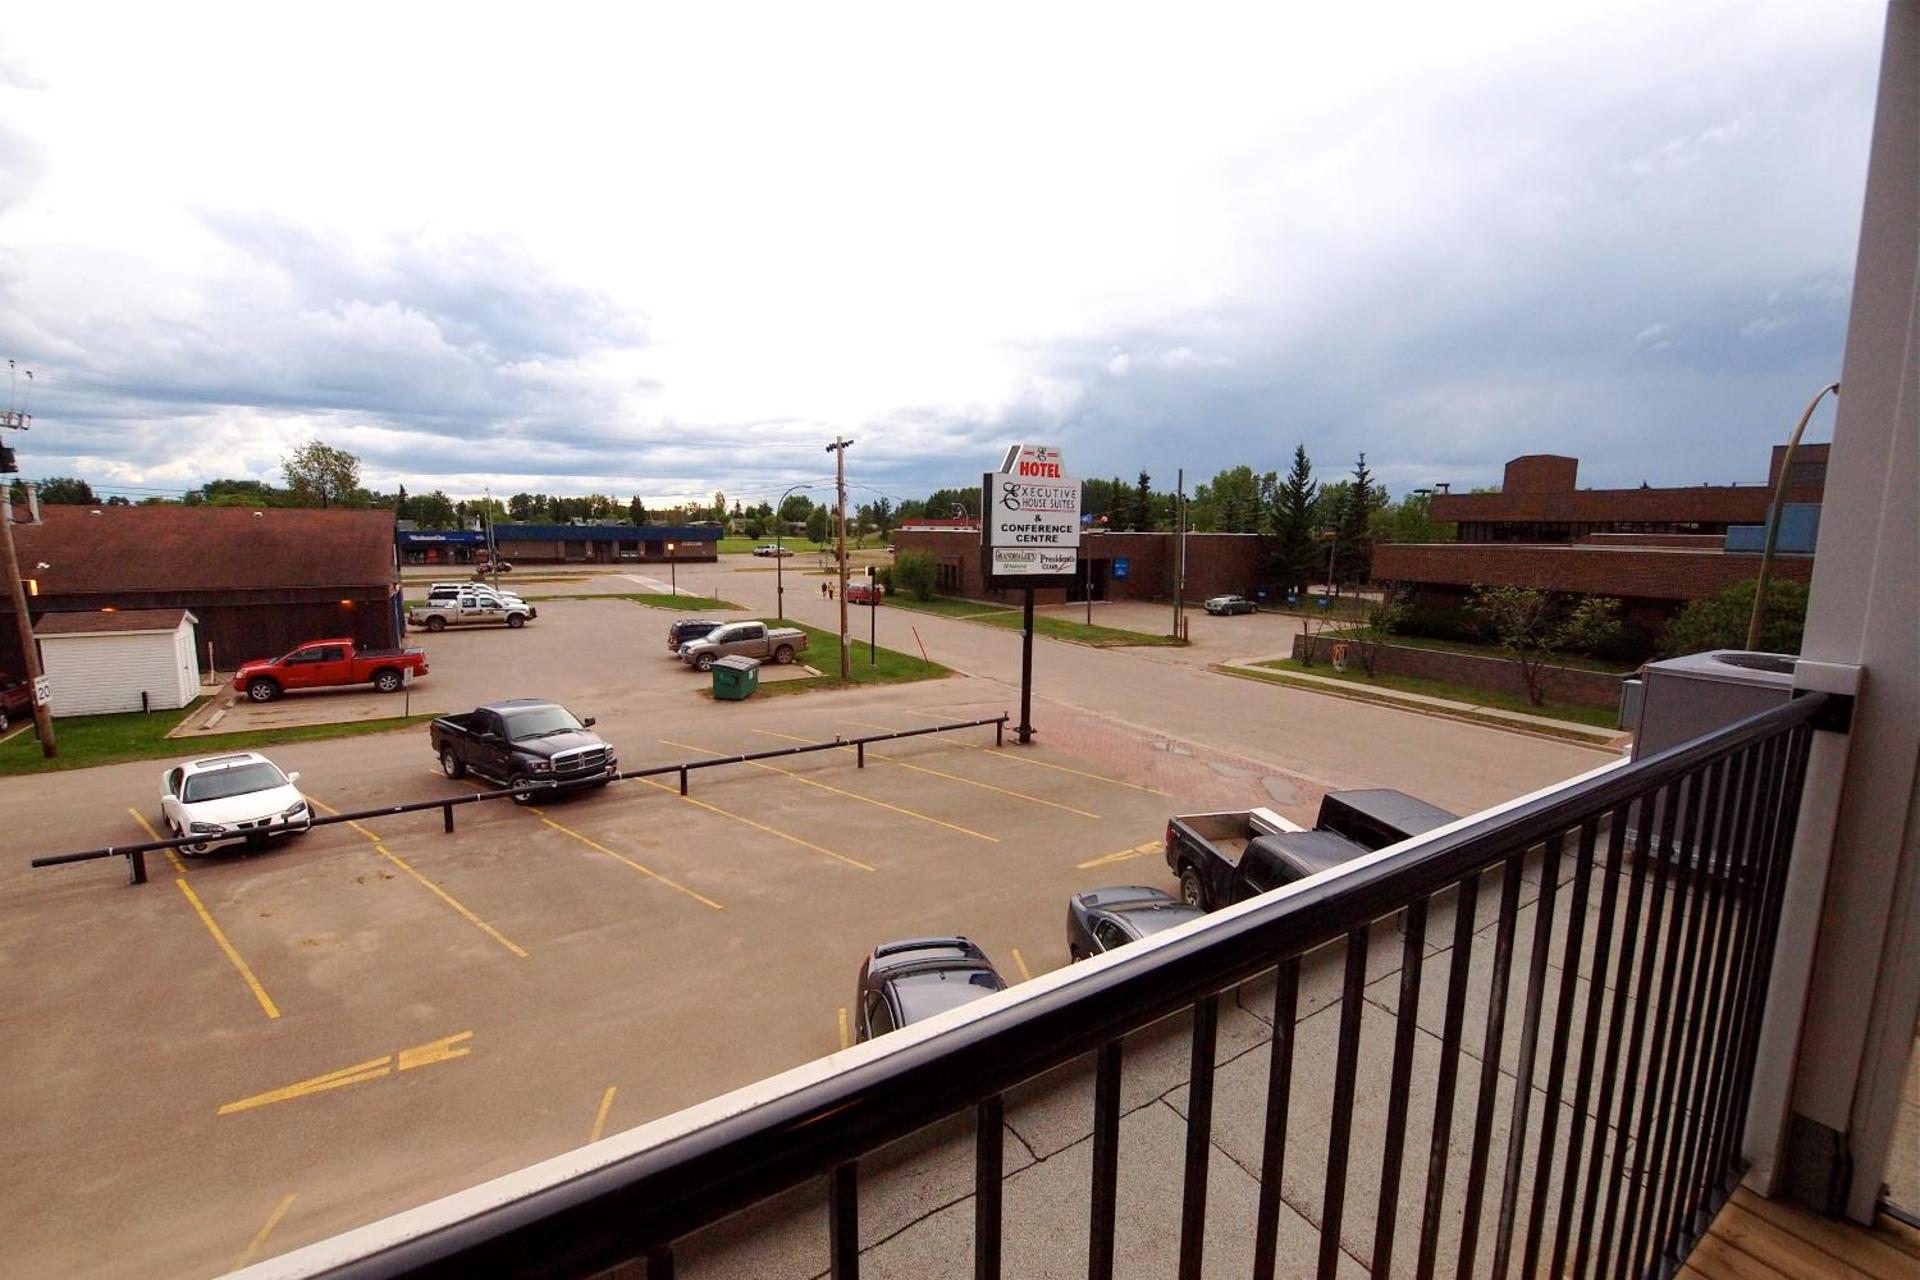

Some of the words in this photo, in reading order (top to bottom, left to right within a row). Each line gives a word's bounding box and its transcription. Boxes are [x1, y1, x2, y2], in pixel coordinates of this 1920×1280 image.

[1019, 461, 1061, 478] HOTEL
[1022, 498, 1046, 509] HOUSE
[1049, 498, 1075, 510] SUITES
[1034, 514, 1042, 522] &
[1001, 523, 1073, 534] CONFERENCE
[1016, 534, 1060, 543] CENTRE
[38, 685, 50, 700] 20
